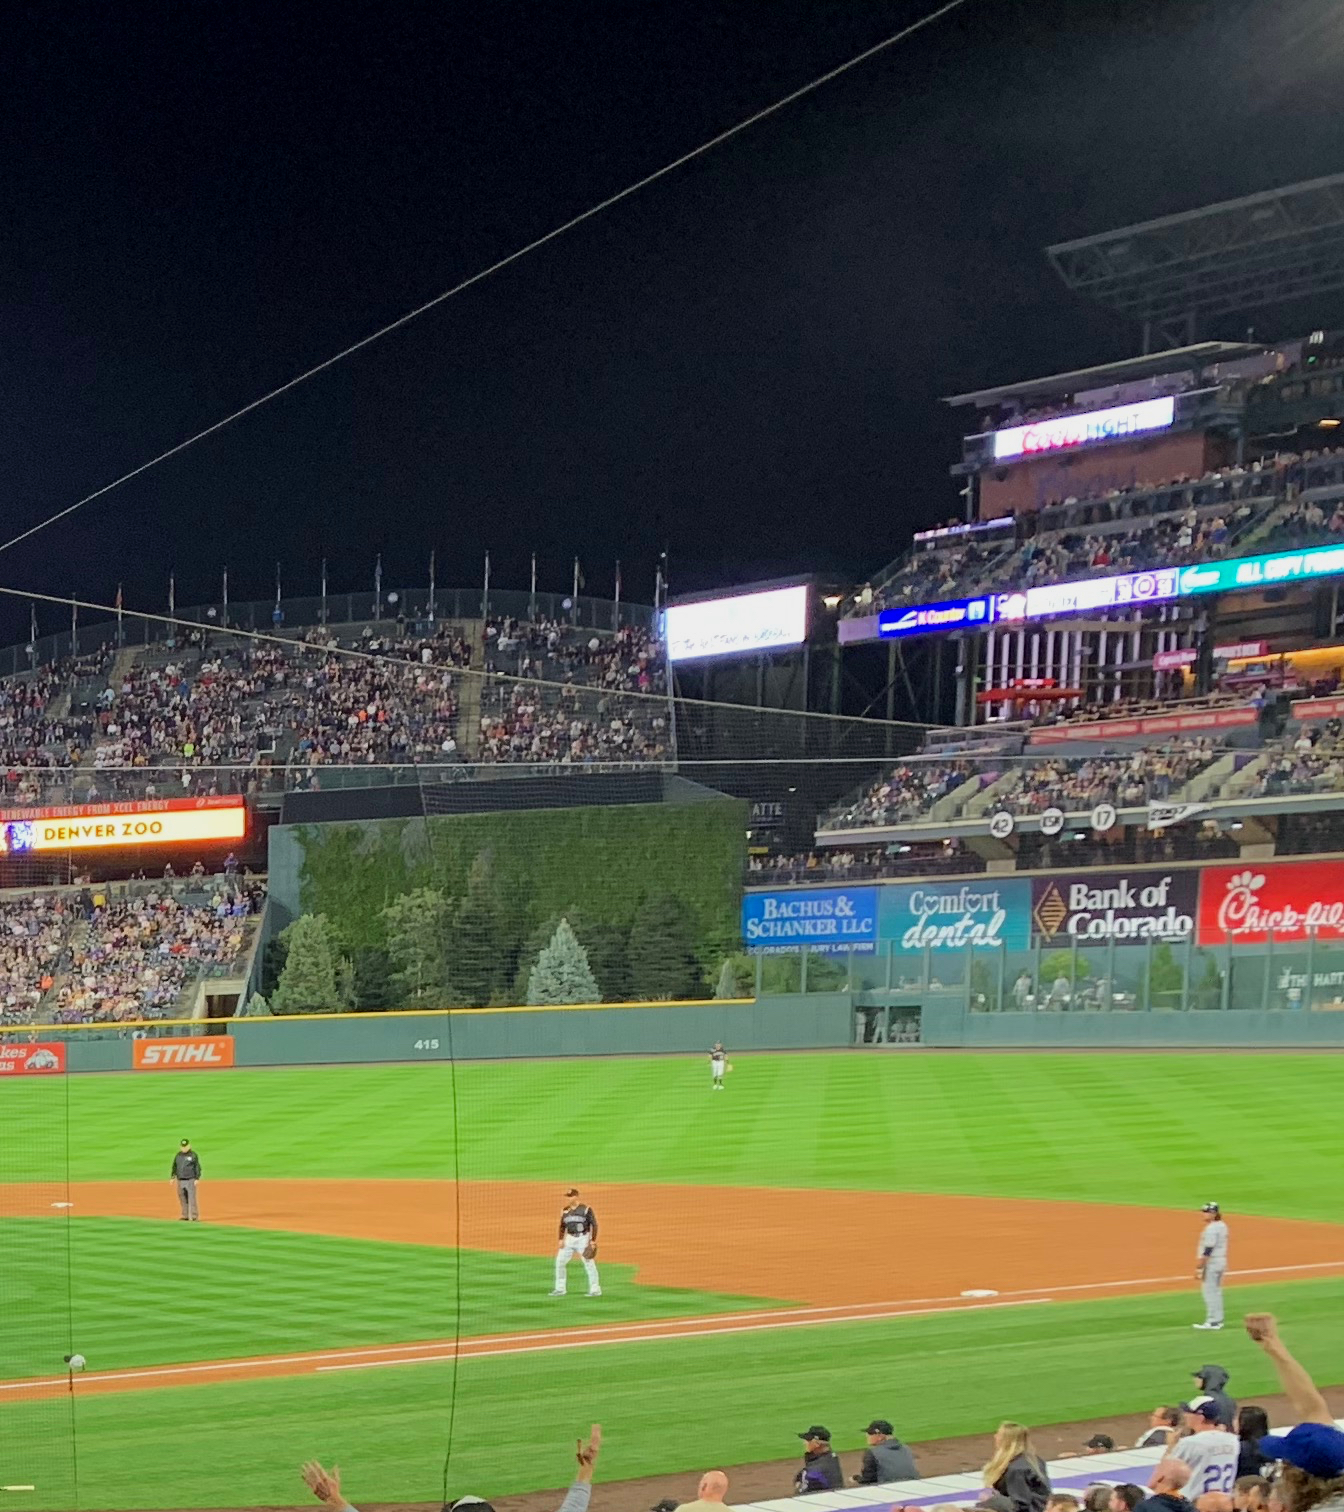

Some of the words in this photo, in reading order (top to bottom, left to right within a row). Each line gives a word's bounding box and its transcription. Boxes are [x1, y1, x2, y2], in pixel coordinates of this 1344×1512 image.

[53, 806, 85, 817] ENERGY
[87, 804, 111, 815] FROM
[113, 802, 135, 813] XCEL
[137, 800, 170, 812] ENERGY
[44, 824, 116, 841] DENVER
[123, 821, 163, 836] ZOO
[992, 817, 1008, 833] 42
[909, 887, 1001, 915] Comfort
[1068, 878, 1137, 911] Bank
[1140, 876, 1172, 908] of
[763, 898, 833, 919] BACHUS
[834, 896, 856, 917] &
[746, 917, 838, 939] SCHANKER
[842, 917, 873, 934] LLC
[901, 909, 1006, 949] dental
[1067, 907, 1194, 940] Colorado
[141, 1044, 221, 1065] STIHL
[413, 1039, 440, 1052] 415
[1203, 1463, 1235, 1494] 22
